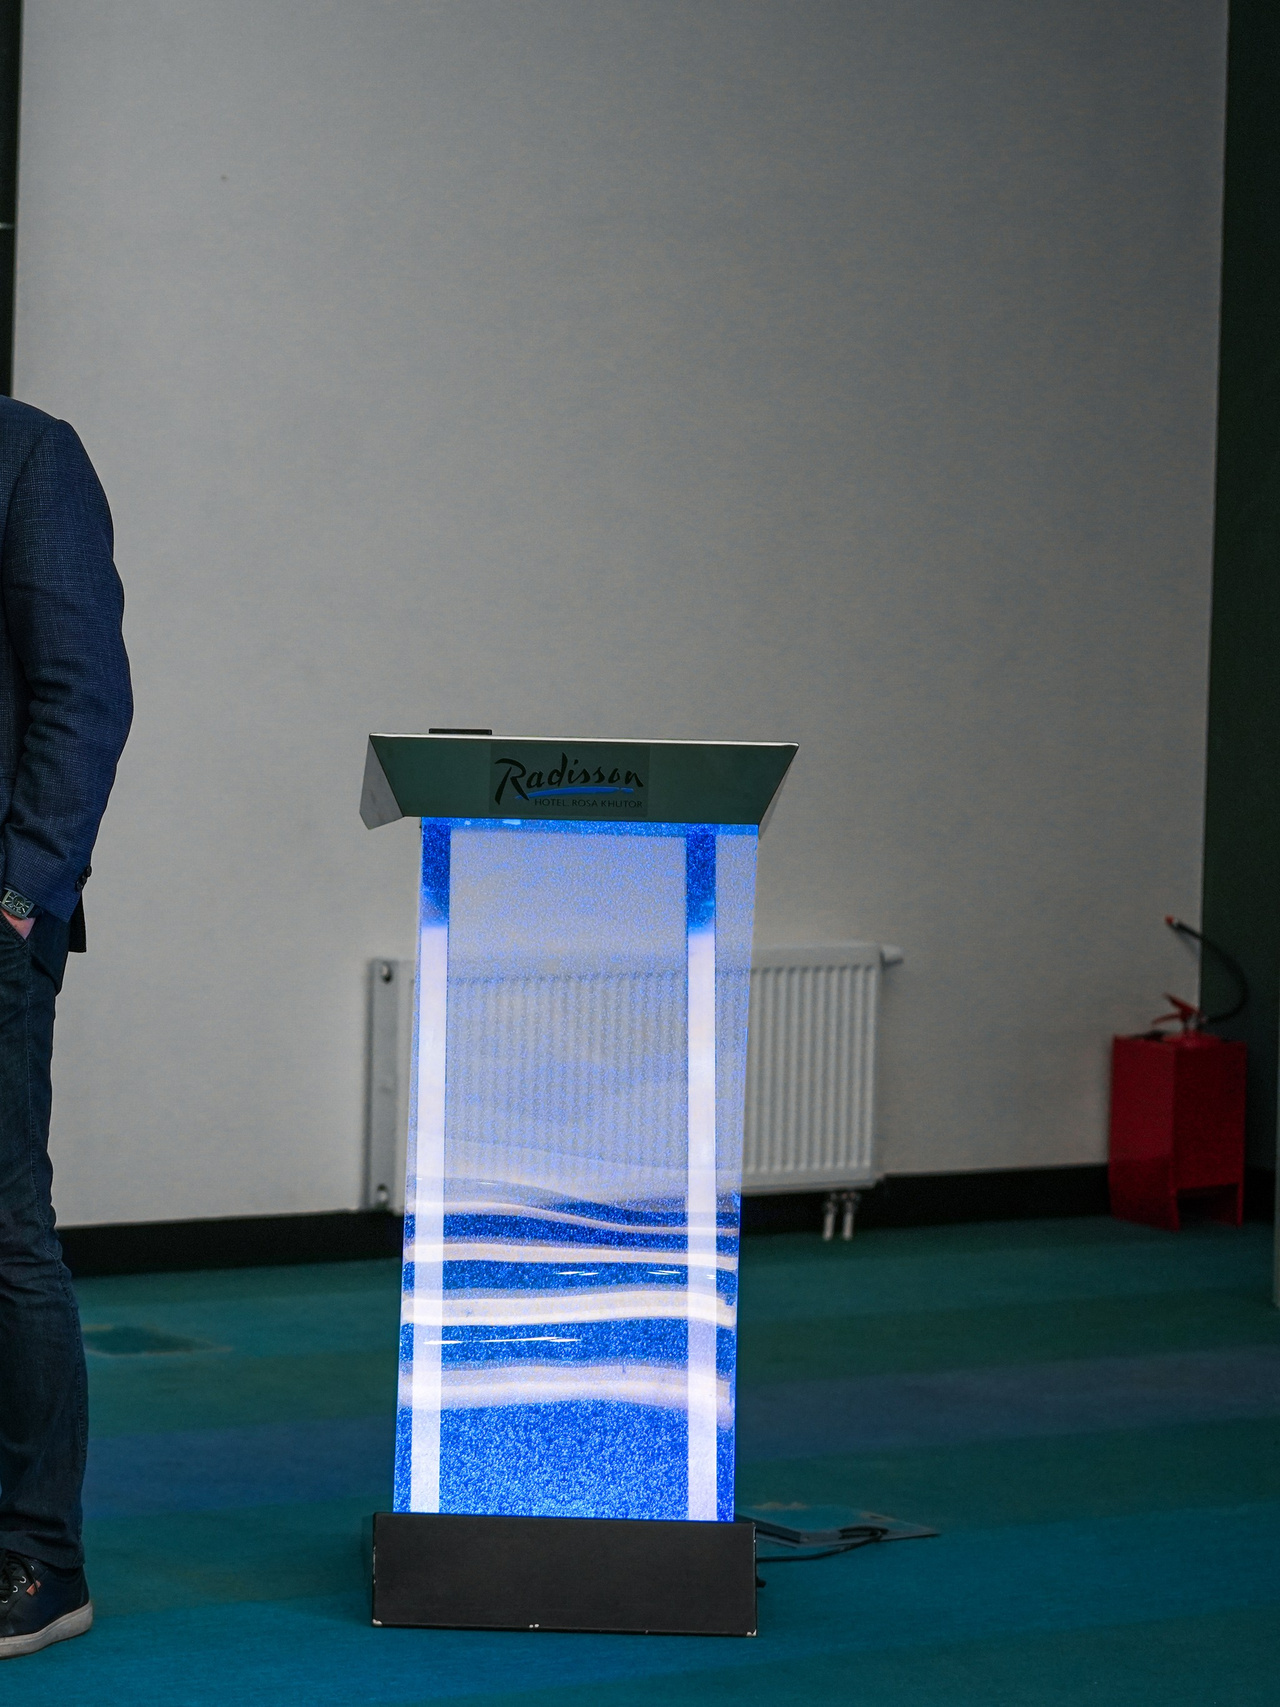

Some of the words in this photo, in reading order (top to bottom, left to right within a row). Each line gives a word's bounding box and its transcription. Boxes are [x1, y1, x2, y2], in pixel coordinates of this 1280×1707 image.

[495, 752, 644, 805] Radisson
[572, 799, 598, 807] ROSA
[600, 799, 643, 808] KHUTOR
